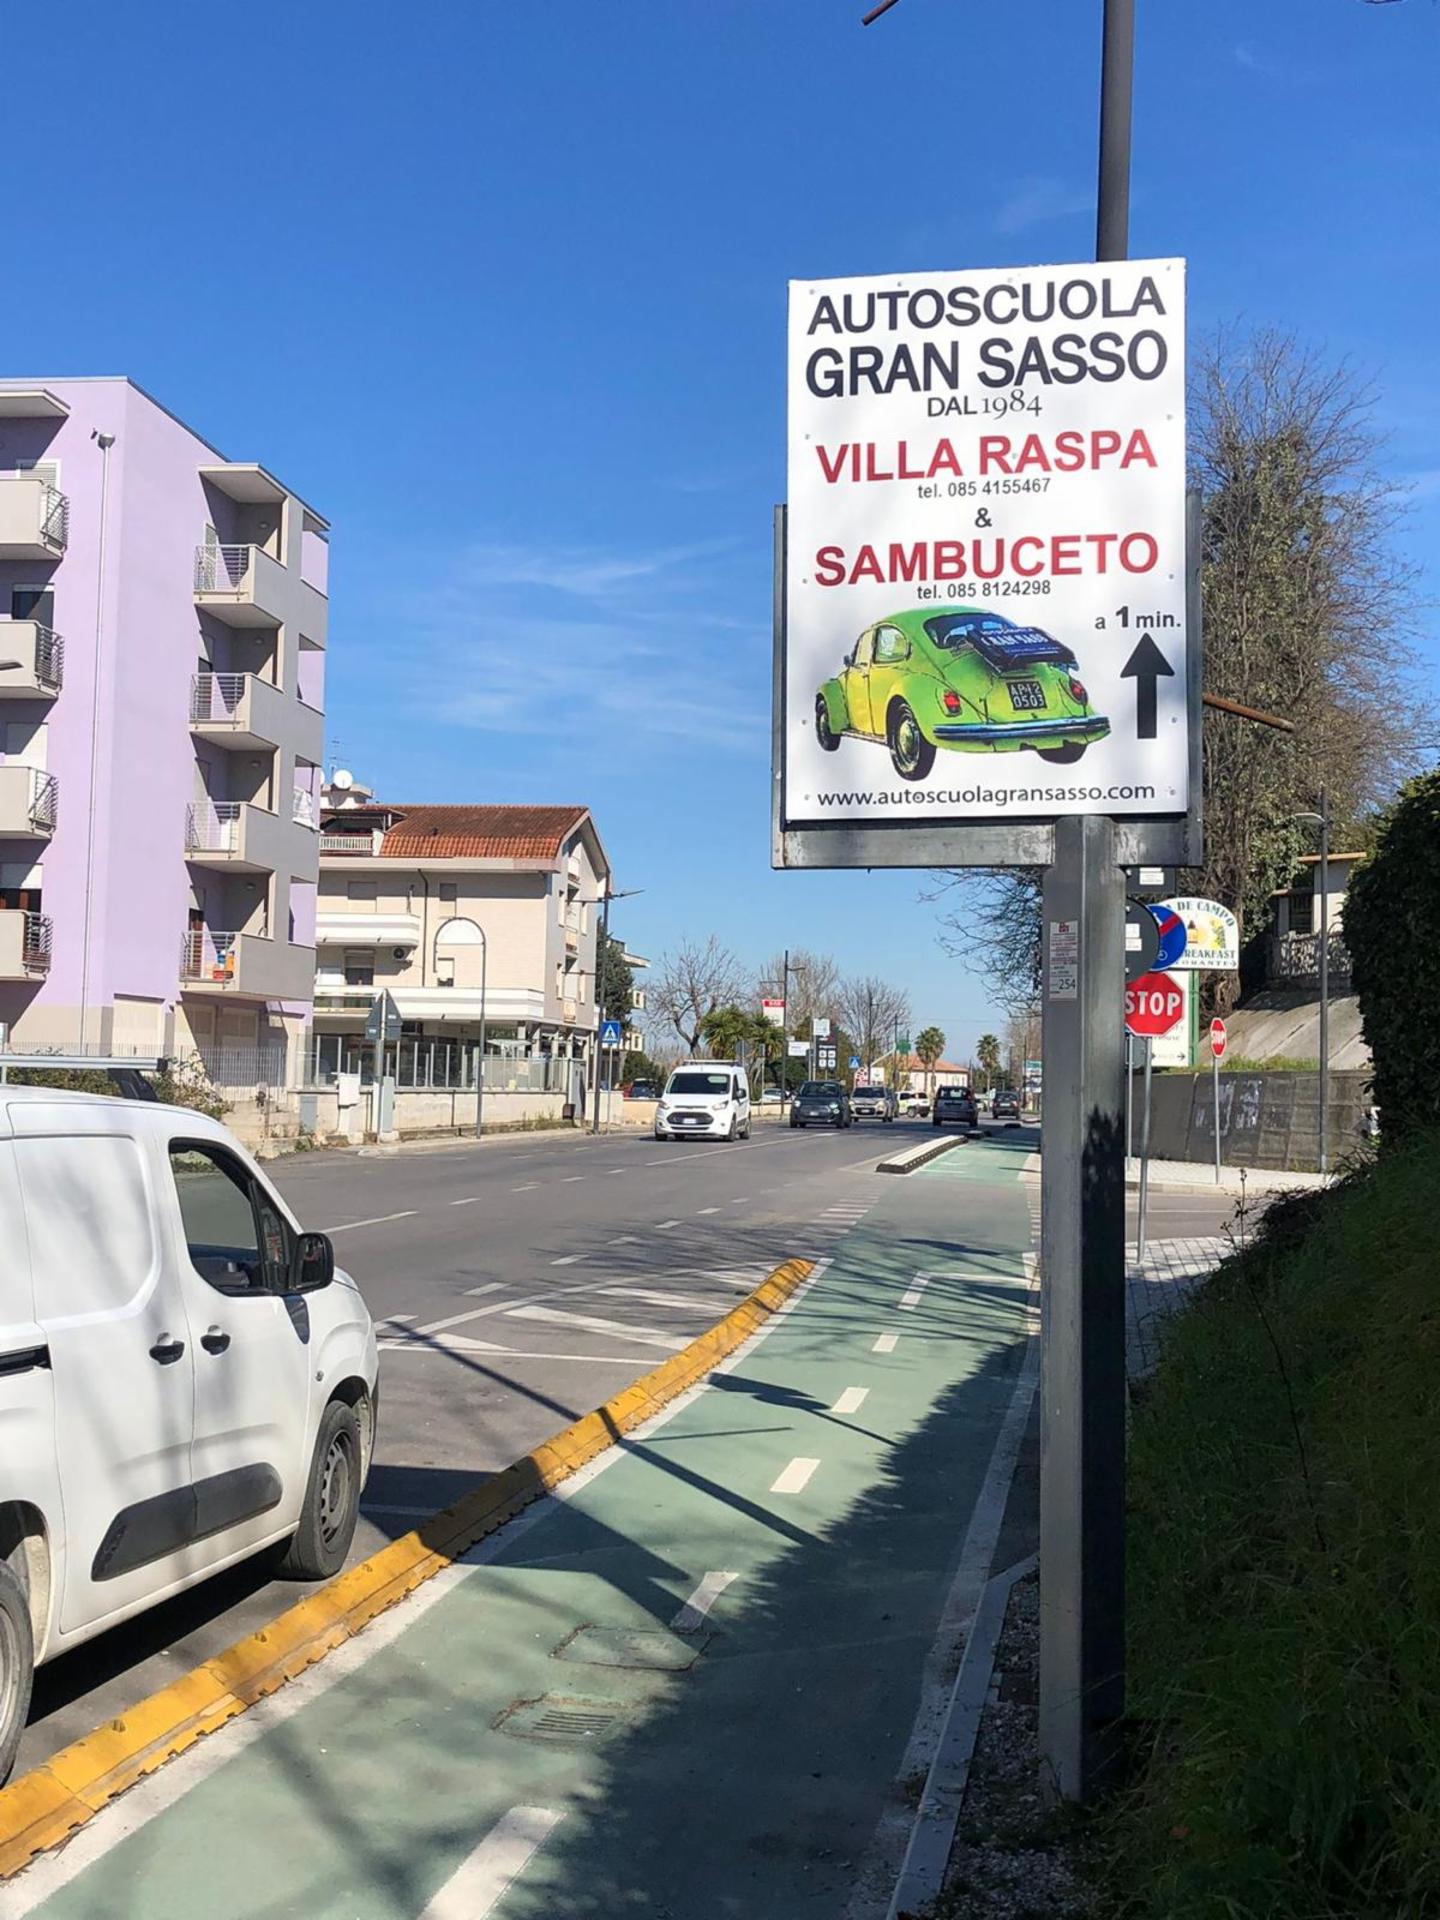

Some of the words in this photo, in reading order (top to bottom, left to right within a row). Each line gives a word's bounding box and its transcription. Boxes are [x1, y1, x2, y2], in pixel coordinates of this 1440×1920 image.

[807, 276, 1167, 335] AUTOSCUOLA
[806, 340, 959, 398] GRAN
[977, 329, 1168, 389] SASSO
[927, 396, 978, 417] DAL
[981, 388, 1043, 419] 1984
[816, 437, 962, 483] VILLA
[979, 429, 1158, 475] RASPA
[917, 484, 941, 499] tel.
[948, 482, 977, 497] 085
[982, 478, 1051, 495] 4155467
[974, 507, 993, 528] &
[814, 532, 1158, 587] SAMBUCETO
[917, 585, 941, 600] tel.
[947, 583, 977, 598] 085
[981, 579, 1051, 597] 8124298
[1095, 616, 1106, 630] a
[1115, 605, 1129, 628] 1
[1135, 610, 1181, 629] min.
[817, 782, 1155, 807] www.autoscuolagransasso.com
[1177, 901, 1193, 911] DE
[1197, 902, 1235, 927] CAMPO
[1183, 949, 1236, 959] REAKFAST
[1059, 978, 1076, 990] 254
[1125, 990, 1181, 1016] STOP
